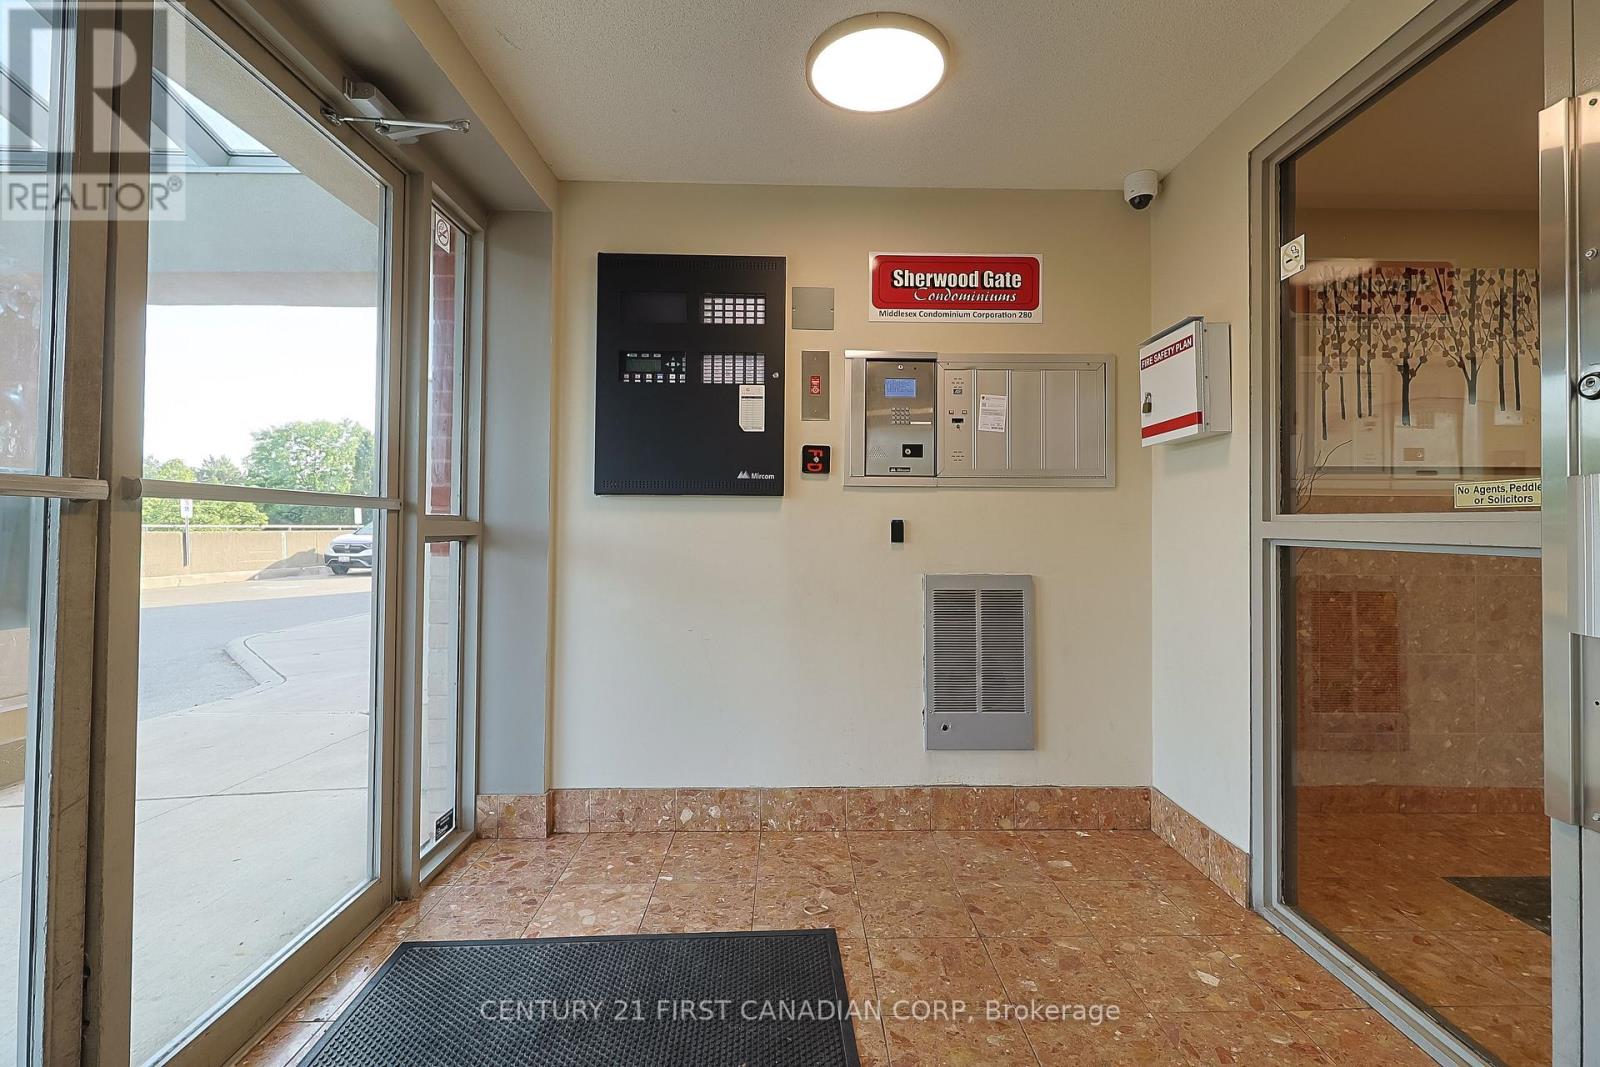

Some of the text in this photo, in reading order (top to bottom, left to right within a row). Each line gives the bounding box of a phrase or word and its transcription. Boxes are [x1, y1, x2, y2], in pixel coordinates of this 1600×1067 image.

[893, 269, 1022, 289] Sherwood Gate
[914, 287, 1017, 302] Condominiums
[878, 310, 1032, 320] Middlesex Condominium Corporation 280
[1141, 337, 1193, 369] FIRE SAFETY PLAN
[751, 471, 775, 480] Mircom
[1457, 486, 1470, 495] No
[1473, 485, 1508, 497] Agents,
[1487, 494, 1534, 504] Solicitors
